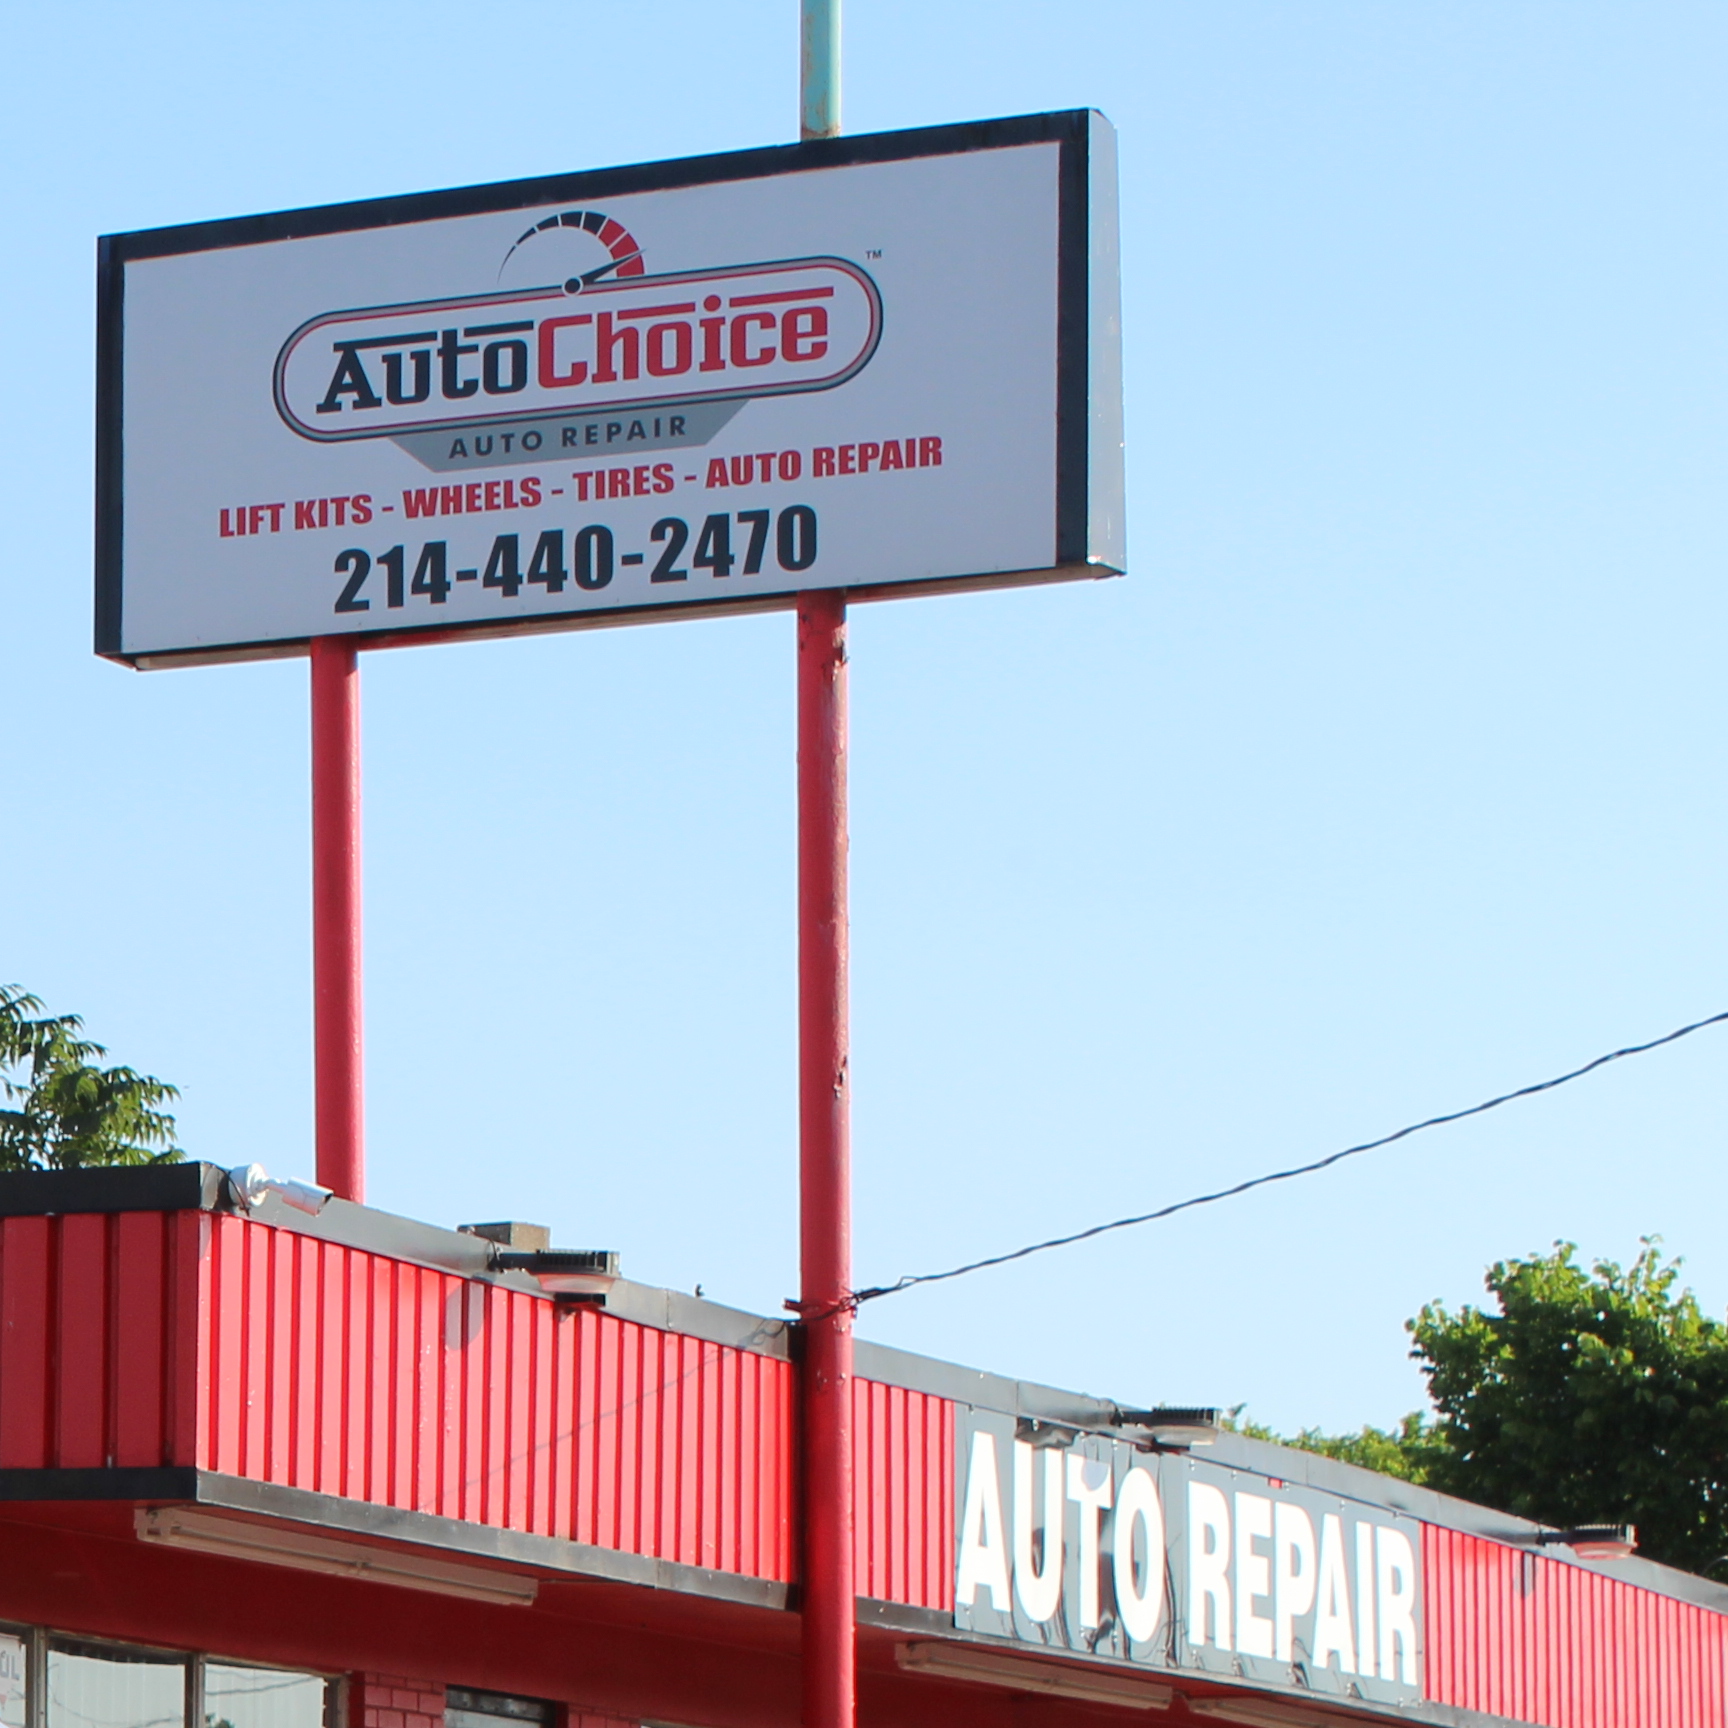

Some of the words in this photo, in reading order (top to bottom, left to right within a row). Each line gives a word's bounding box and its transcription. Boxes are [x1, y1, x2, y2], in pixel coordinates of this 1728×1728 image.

[219, 503, 285, 537] LIFT
[294, 494, 373, 530] KITS
[403, 477, 542, 519] WHEELS
[573, 463, 675, 501] TIRES
[705, 450, 801, 488] AUTO
[813, 436, 943, 478] REPAIR
[449, 430, 542, 460] AUTO
[561, 415, 687, 447] REPAIR
[334, 504, 817, 614] 214-440-2470
[956, 1430, 1165, 1643] AUTO
[1188, 1480, 1418, 1686] REPAIR
